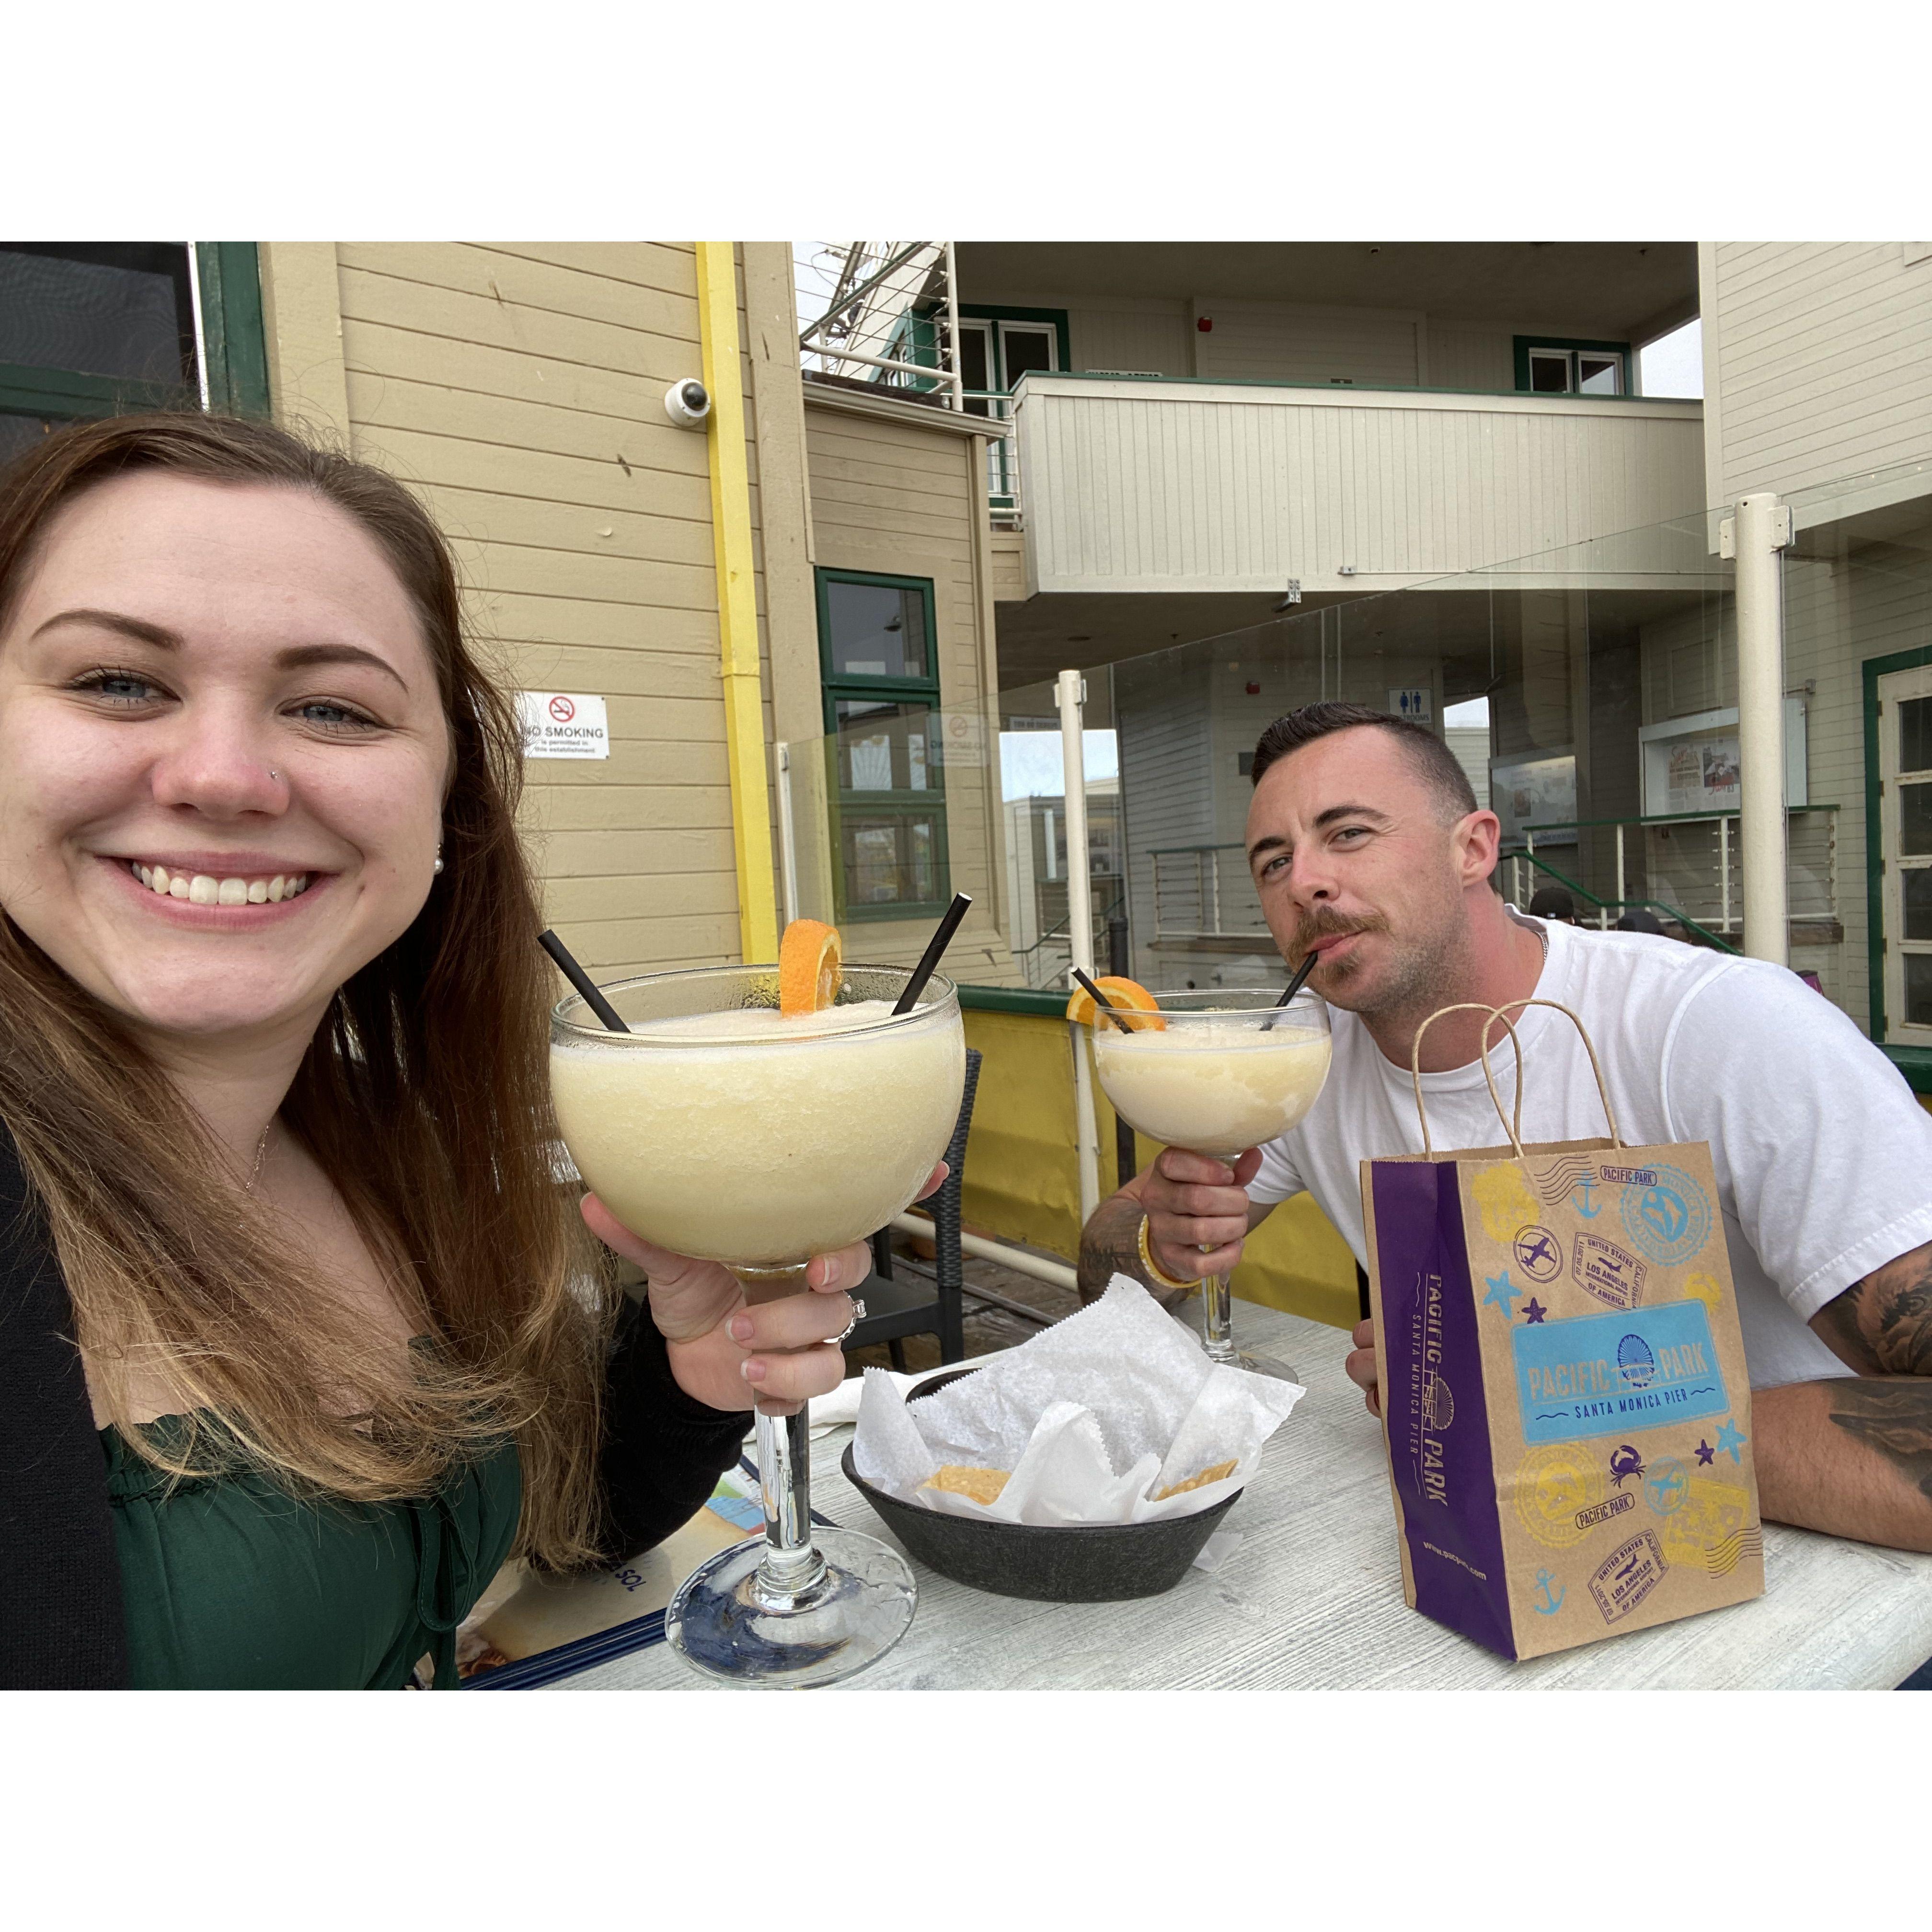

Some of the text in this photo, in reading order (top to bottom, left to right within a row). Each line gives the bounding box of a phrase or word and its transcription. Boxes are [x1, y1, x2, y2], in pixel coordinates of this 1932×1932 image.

[545, 726, 603, 738] SMOKING
[1603, 1168, 1653, 1184] PACIFIC PARK
[1587, 1239, 1633, 1268] UNITED STATES
[1585, 1271, 1614, 1289] INTERNATIONAL
[1587, 1262, 1628, 1291] LOS ANGELES
[1632, 1265, 1642, 1309] CALIFORNIA
[1588, 1282, 1625, 1307] OF AMERICA
[1410, 1314, 1422, 1454] SANTA MONICA PIER
[1527, 1343, 1709, 1400] PACIFIC PARK
[1424, 1274, 1449, 1507] PACIFIC PARK
[1575, 1388, 1688, 1419] SANTA MONICA PIER
[1579, 1496, 1630, 1527] PACIFIC PARK
[1598, 1539, 1644, 1581] UNITED STATES
[1645, 1533, 1665, 1572] CALIFORNIA
[1611, 1560, 1652, 1600] LOS ANGELES
[1615, 1567, 1654, 1606] INTERNATIONAL AIRPORT
[1622, 1577, 1655, 1611] OF AMERICA
